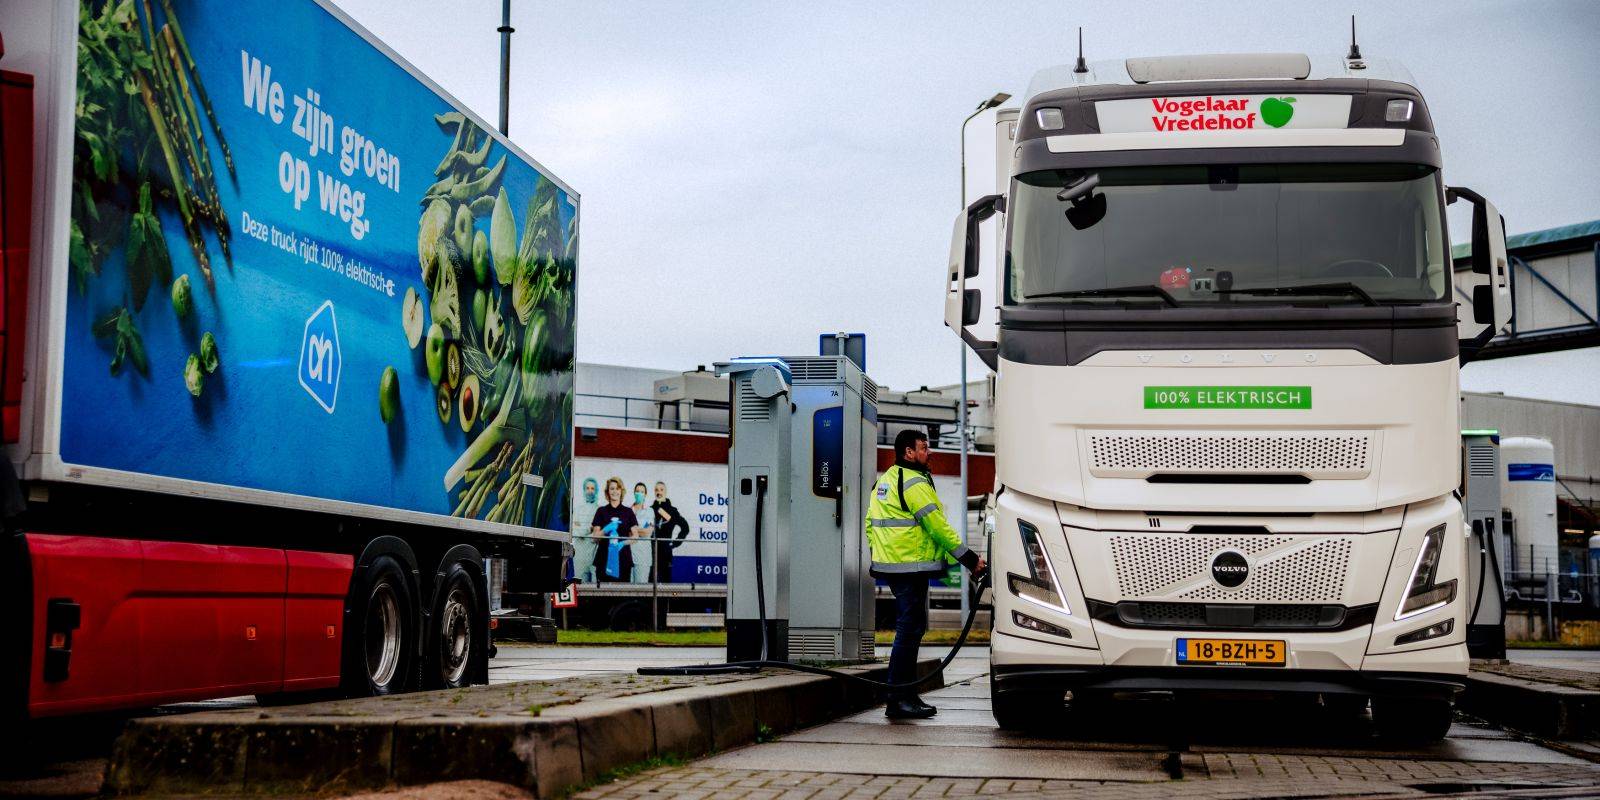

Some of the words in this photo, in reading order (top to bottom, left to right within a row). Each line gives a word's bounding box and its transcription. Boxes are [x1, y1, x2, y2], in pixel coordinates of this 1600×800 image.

[1152, 96, 1249, 117] Vogelaar
[241, 49, 285, 125] We
[292, 87, 334, 157] zijn
[340, 125, 400, 194] groen
[1152, 113, 1256, 132] Vredehof
[278, 151, 311, 210] op
[317, 169, 370, 241] weg.
[242, 211, 269, 242] Deze
[271, 225, 297, 255] truck
[299, 237, 318, 264] rijdt
[321, 246, 344, 275] 100%
[345, 258, 385, 293] elektrisch
[1155, 391, 1190, 404] 100%
[1197, 391, 1301, 404] ELEKTRISCH
[820, 461, 829, 488] heliox
[699, 493, 714, 506] De
[699, 513, 724, 523] voor
[697, 565, 728, 575] FOOD
[1195, 642, 1276, 660] 18-BZH-5
